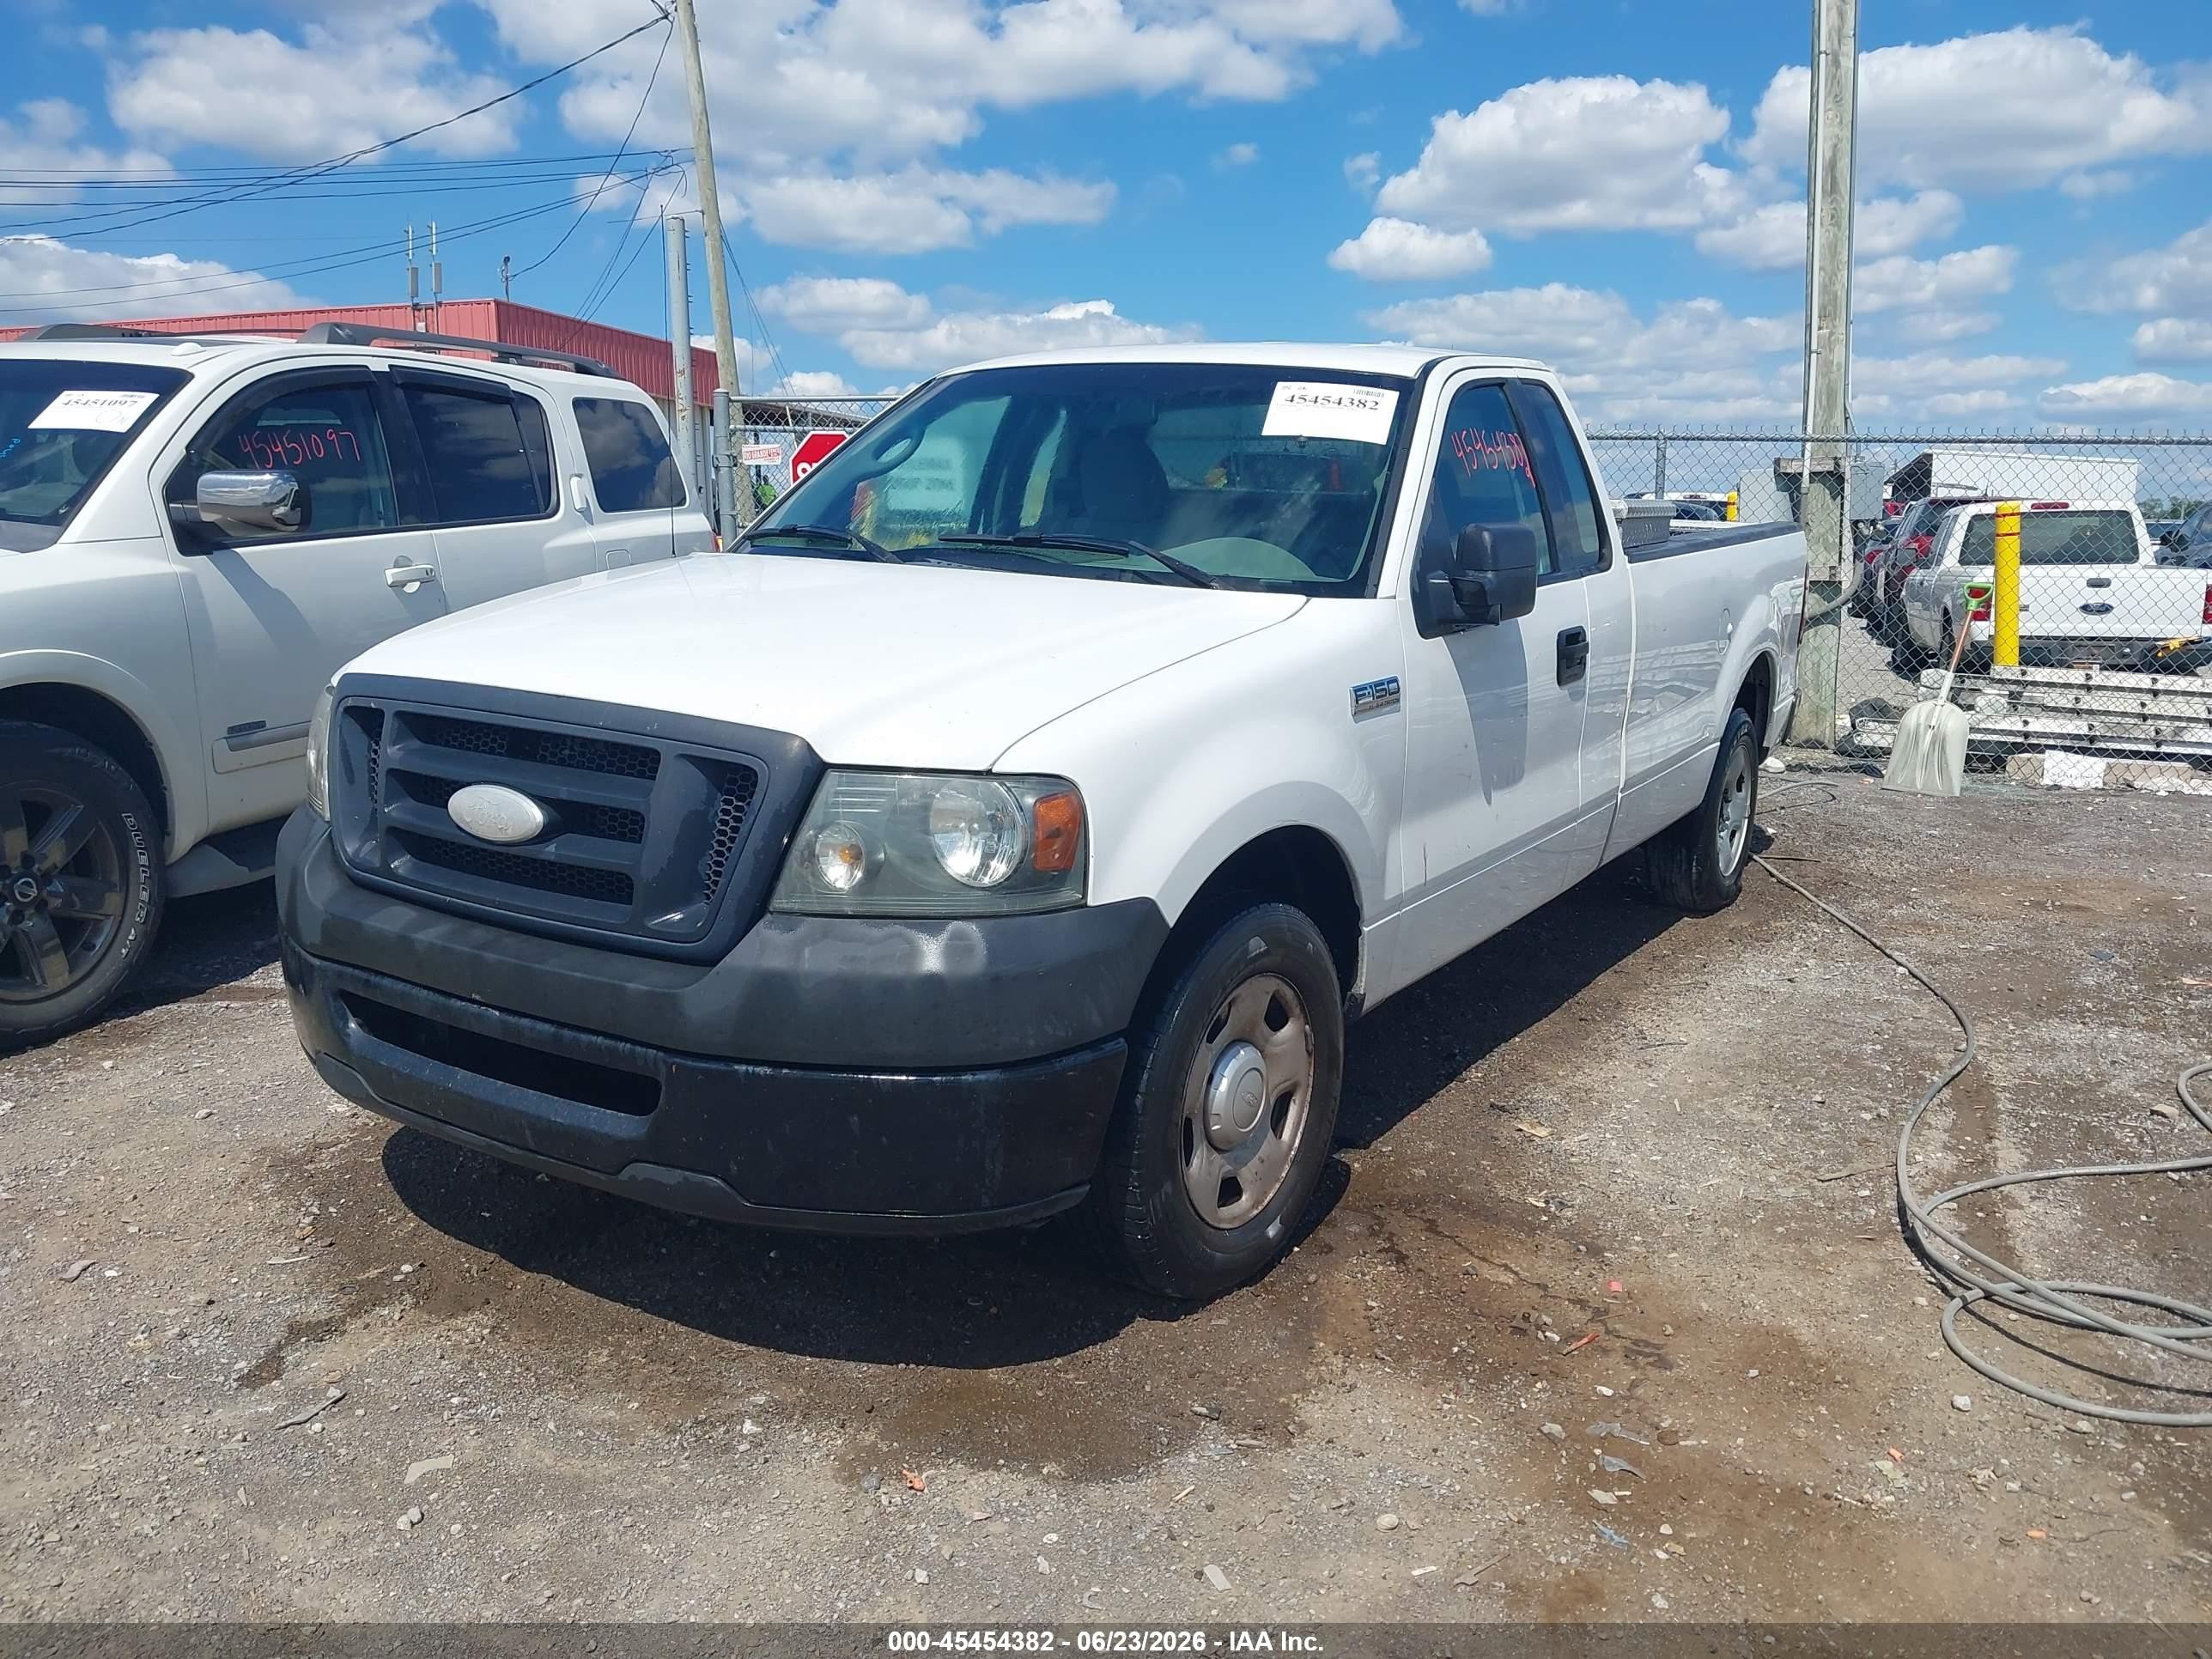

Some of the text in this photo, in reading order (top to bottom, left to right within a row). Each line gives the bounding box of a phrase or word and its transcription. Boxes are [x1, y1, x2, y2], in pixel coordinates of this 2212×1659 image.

[62, 398, 138, 408] 45451097
[1285, 393, 1379, 410] 45454382
[238, 428, 361, 469] 45451097
[121, 812, 150, 924] DUELER
